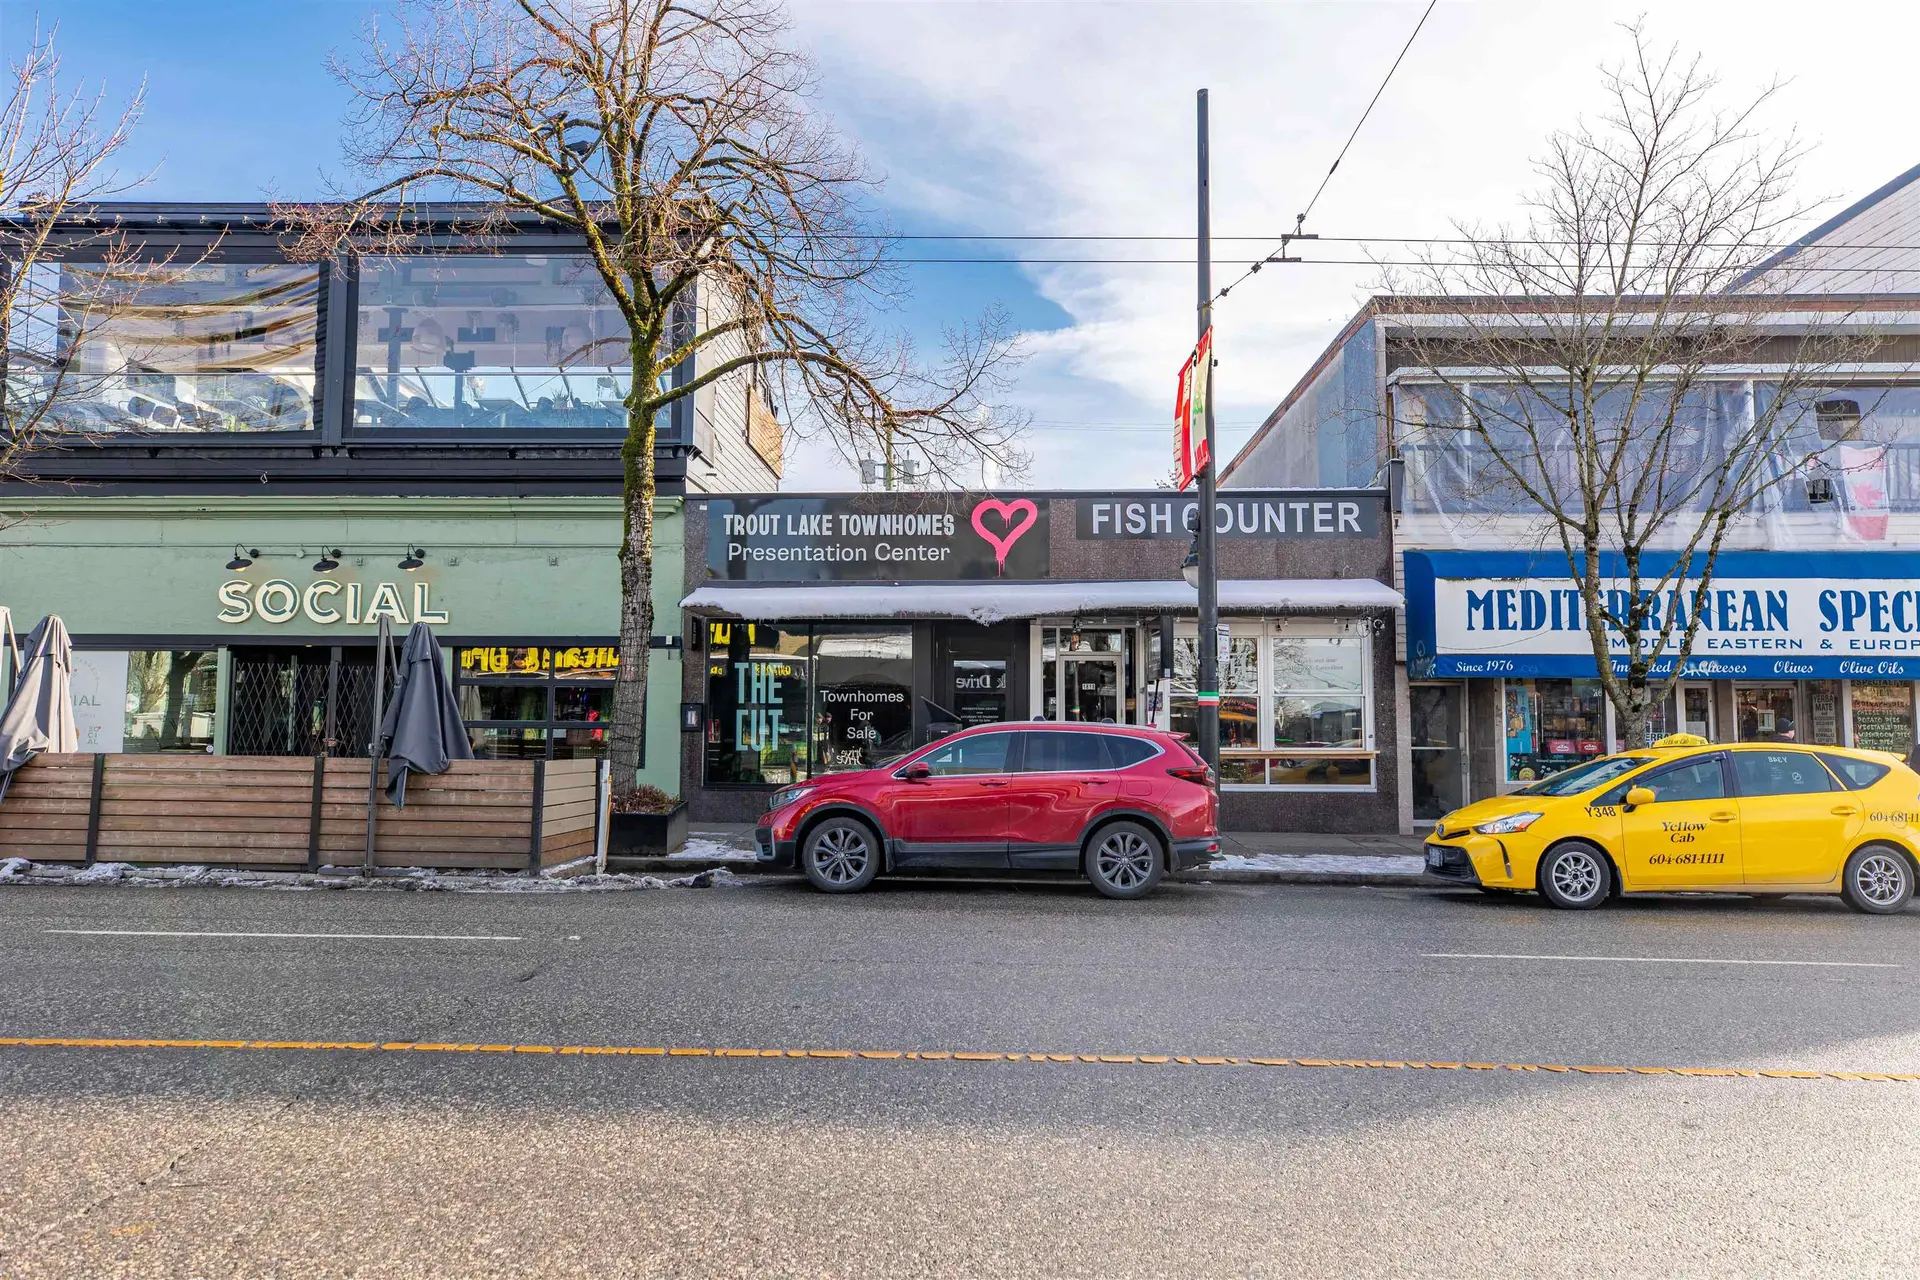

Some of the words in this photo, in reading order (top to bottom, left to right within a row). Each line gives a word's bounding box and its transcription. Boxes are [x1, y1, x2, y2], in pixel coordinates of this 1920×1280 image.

[1092, 503, 1172, 534] FISH
[723, 514, 780, 536] TROUT
[787, 514, 833, 536] LAKE
[839, 514, 955, 537] TOWNHOMES
[728, 543, 867, 562] Presentation
[874, 542, 951, 562] Center
[217, 578, 449, 624] SOCIAL
[1707, 638, 1802, 649] EASTERN
[1820, 639, 1833, 650] &
[1849, 639, 1920, 650] EUROP
[1456, 661, 1484, 673] Since
[1486, 660, 1514, 672] 1976
[1698, 660, 1747, 673] Cheeses
[1773, 660, 1814, 674] Olives
[1839, 660, 1874, 674] Olive
[1877, 661, 1904, 675] Oils
[734, 662, 783, 704] THE
[820, 690, 905, 703] Townhomes
[1815, 703, 1833, 711] MATE
[850, 708, 874, 721] For
[735, 709, 783, 752] CUT
[846, 726, 877, 739] Sale
[1584, 806, 1617, 818] Y348
[1662, 821, 1708, 832] Yellow
[1670, 833, 1695, 843] Cab
[1649, 853, 1725, 865] 604-681-1111
